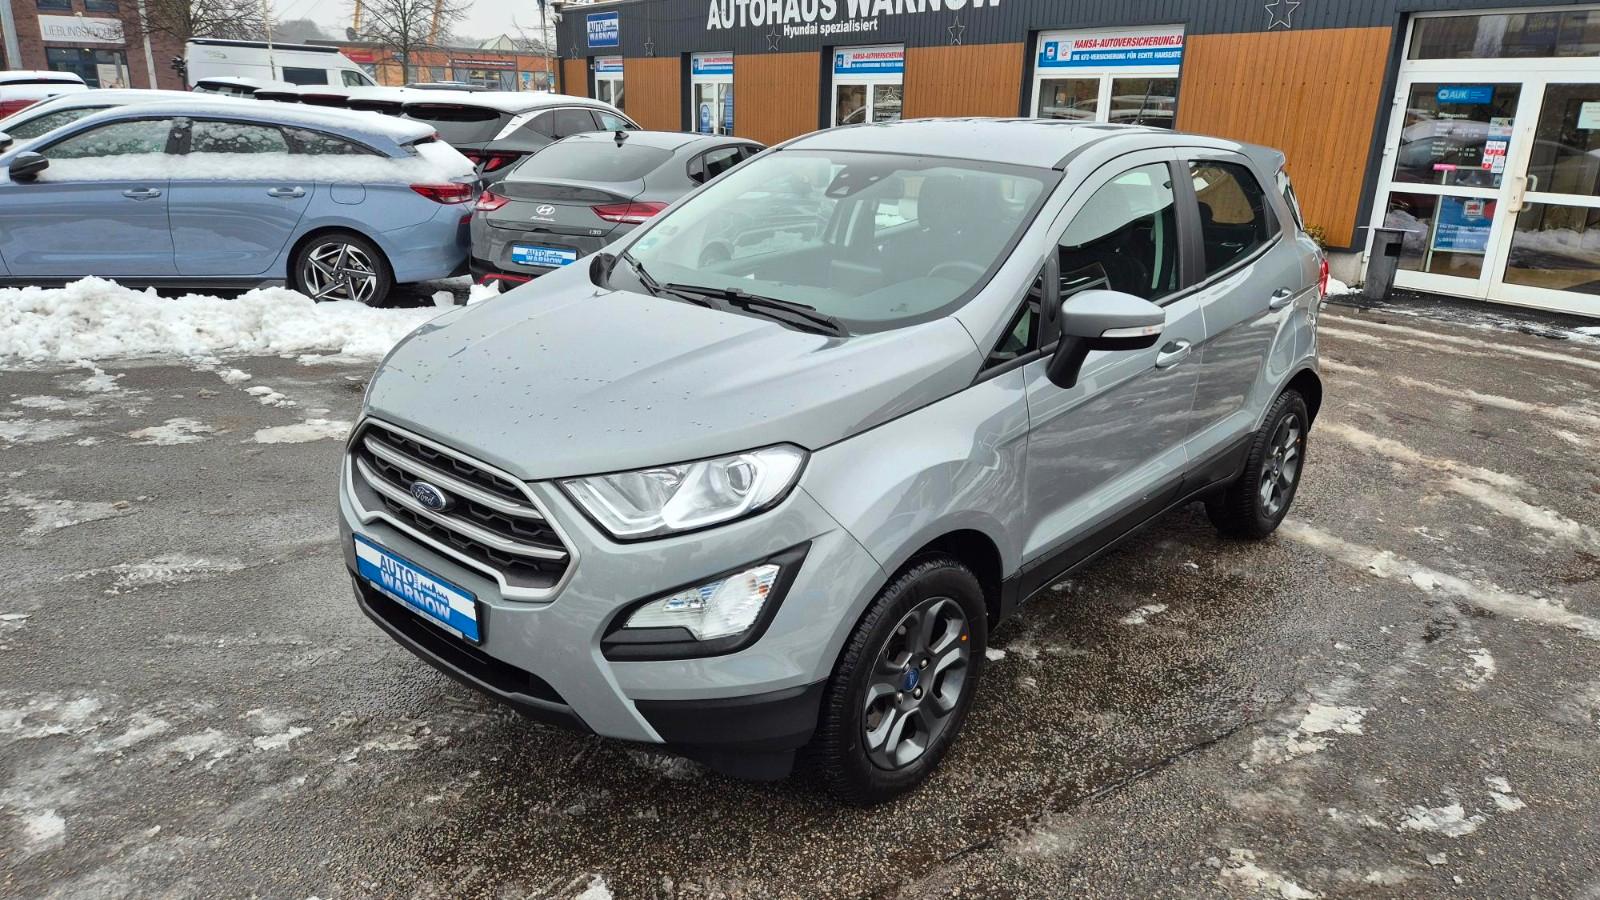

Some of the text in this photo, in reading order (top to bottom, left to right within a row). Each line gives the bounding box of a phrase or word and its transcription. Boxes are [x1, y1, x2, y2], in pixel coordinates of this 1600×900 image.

[706, 0, 838, 30] AUTOHAUS
[590, 21, 604, 32] AUTO
[783, 18, 878, 38] Hyundai spezialisiert
[1127, 50, 1137, 59] FÜR
[1137, 51, 1154, 59] ECHTE
[526, 249, 546, 257] AUTO
[526, 255, 563, 264] WARNOW
[415, 487, 435, 506] Ford
[380, 555, 414, 587] AUTO
[380, 569, 450, 621] WARNOW
